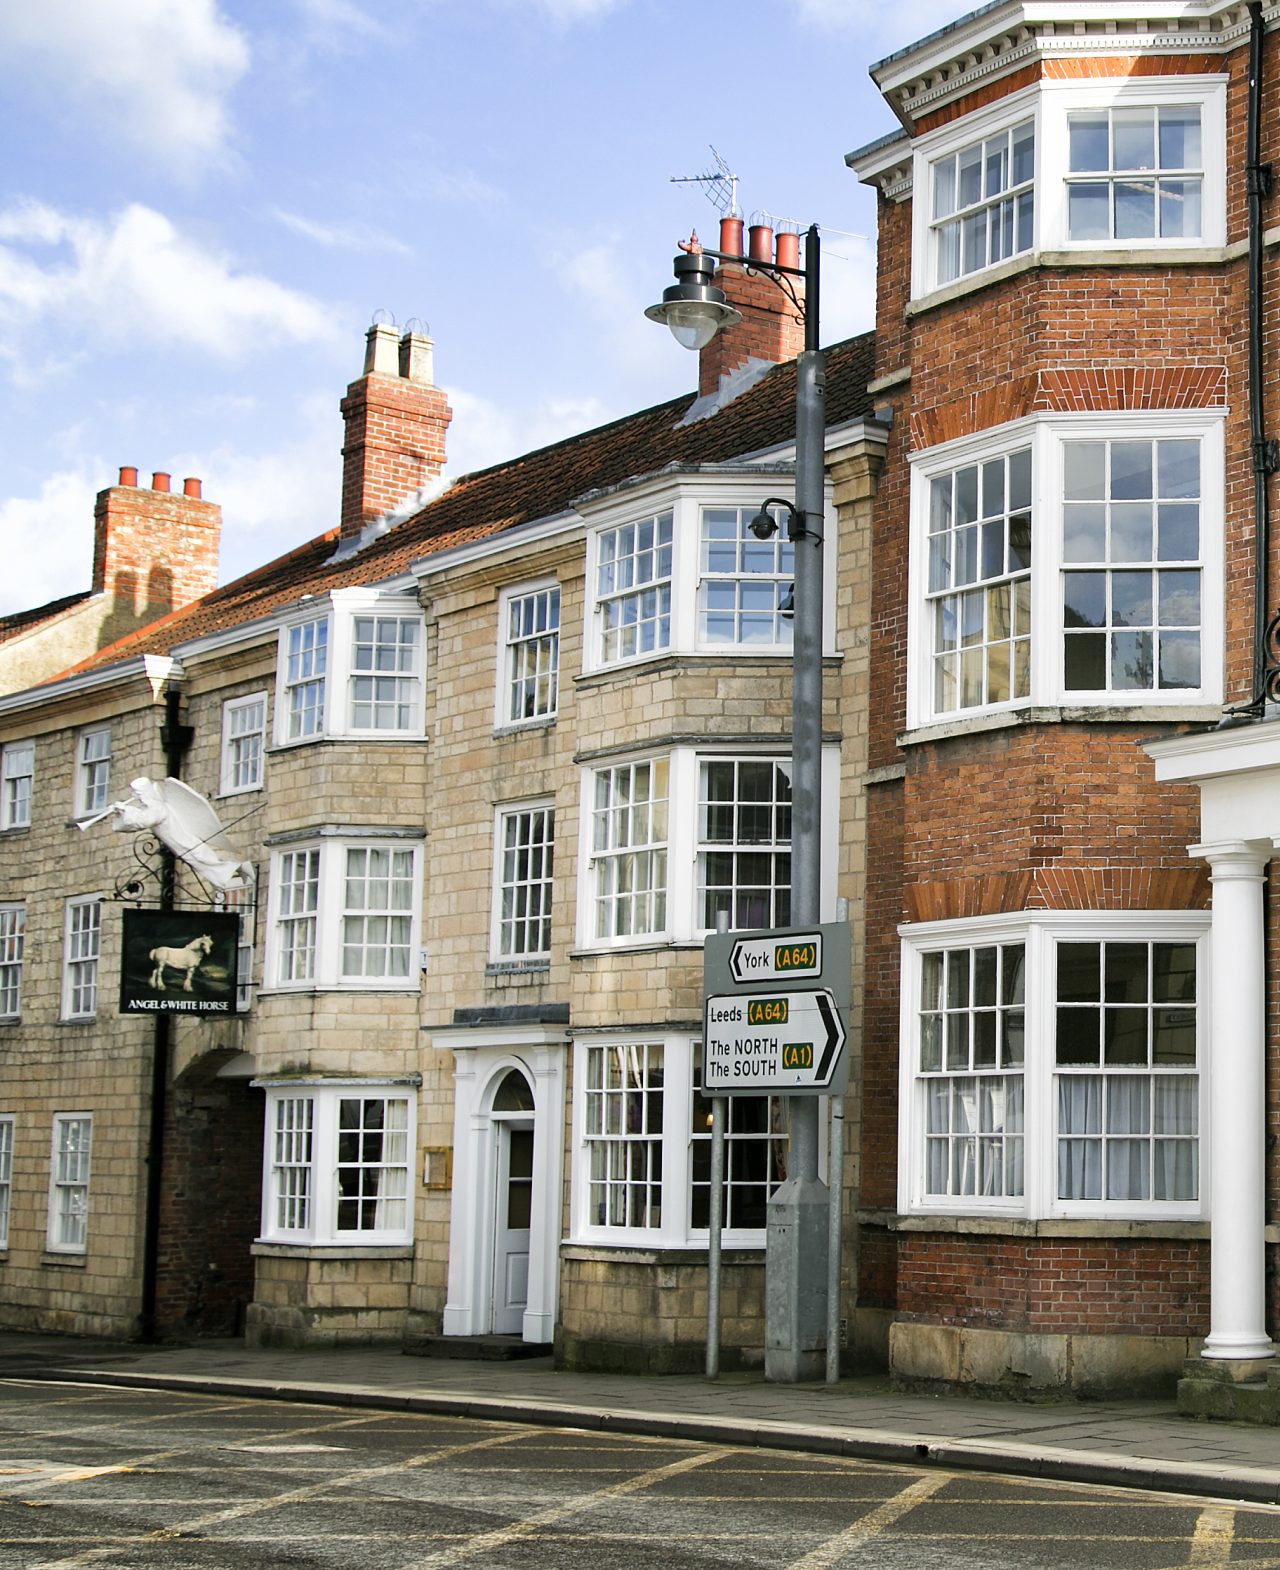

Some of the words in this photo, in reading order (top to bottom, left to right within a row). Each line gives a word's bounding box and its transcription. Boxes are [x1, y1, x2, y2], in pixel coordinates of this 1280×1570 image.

[744, 951, 770, 969] York
[776, 945, 815, 969] (A64)
[199, 1001, 229, 1011] HORSE
[711, 1006, 742, 1023] Leeds
[749, 1000, 787, 1023] (A64)
[710, 1040, 730, 1056] The
[734, 1038, 778, 1055] NORTH
[783, 1045, 812, 1067] (A1)
[710, 1061, 730, 1077] The
[733, 1060, 777, 1077] SOUTH
